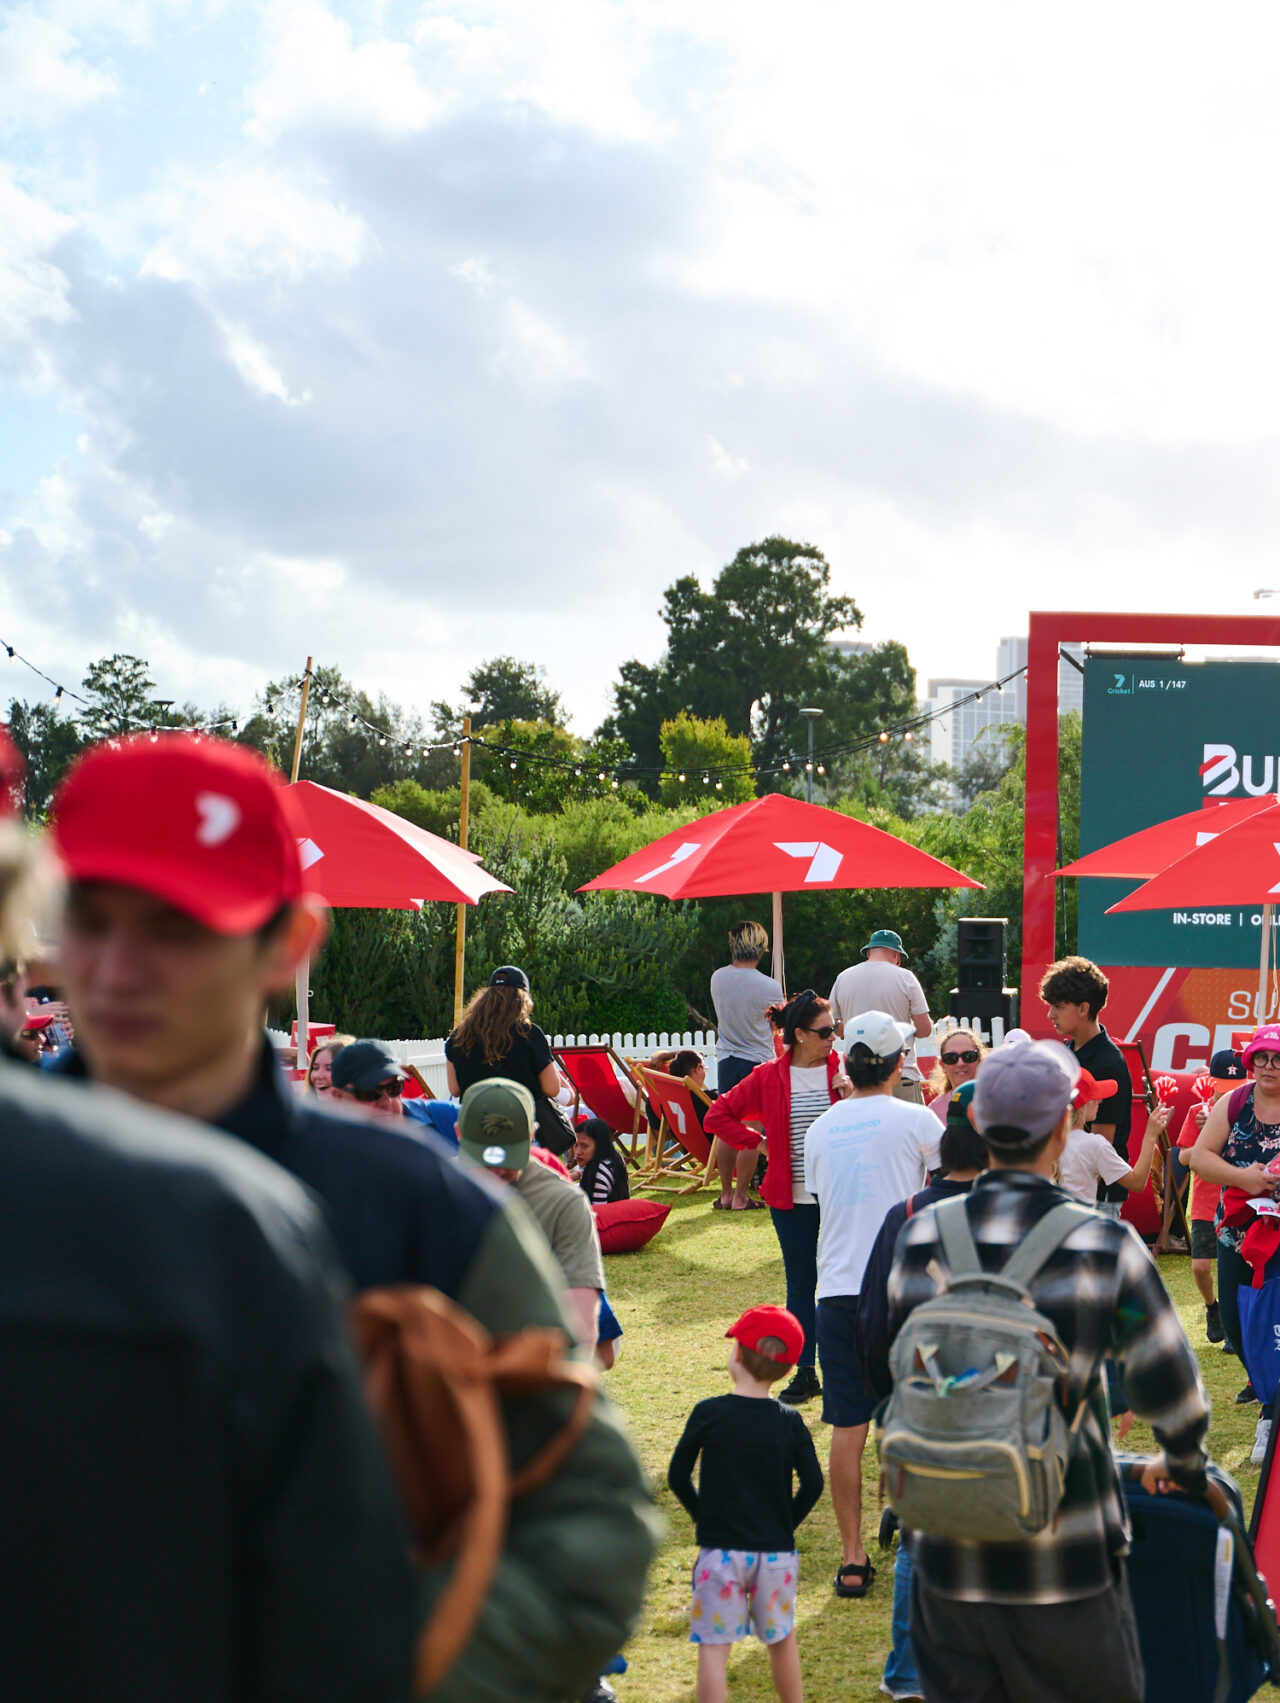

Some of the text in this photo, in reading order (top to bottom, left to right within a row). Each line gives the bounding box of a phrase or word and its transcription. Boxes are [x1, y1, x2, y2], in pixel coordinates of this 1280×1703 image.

[1139, 680, 1155, 688] AUS
[1107, 687, 1131, 695] Cricket
[1173, 912, 1232, 925] IN-STORE
